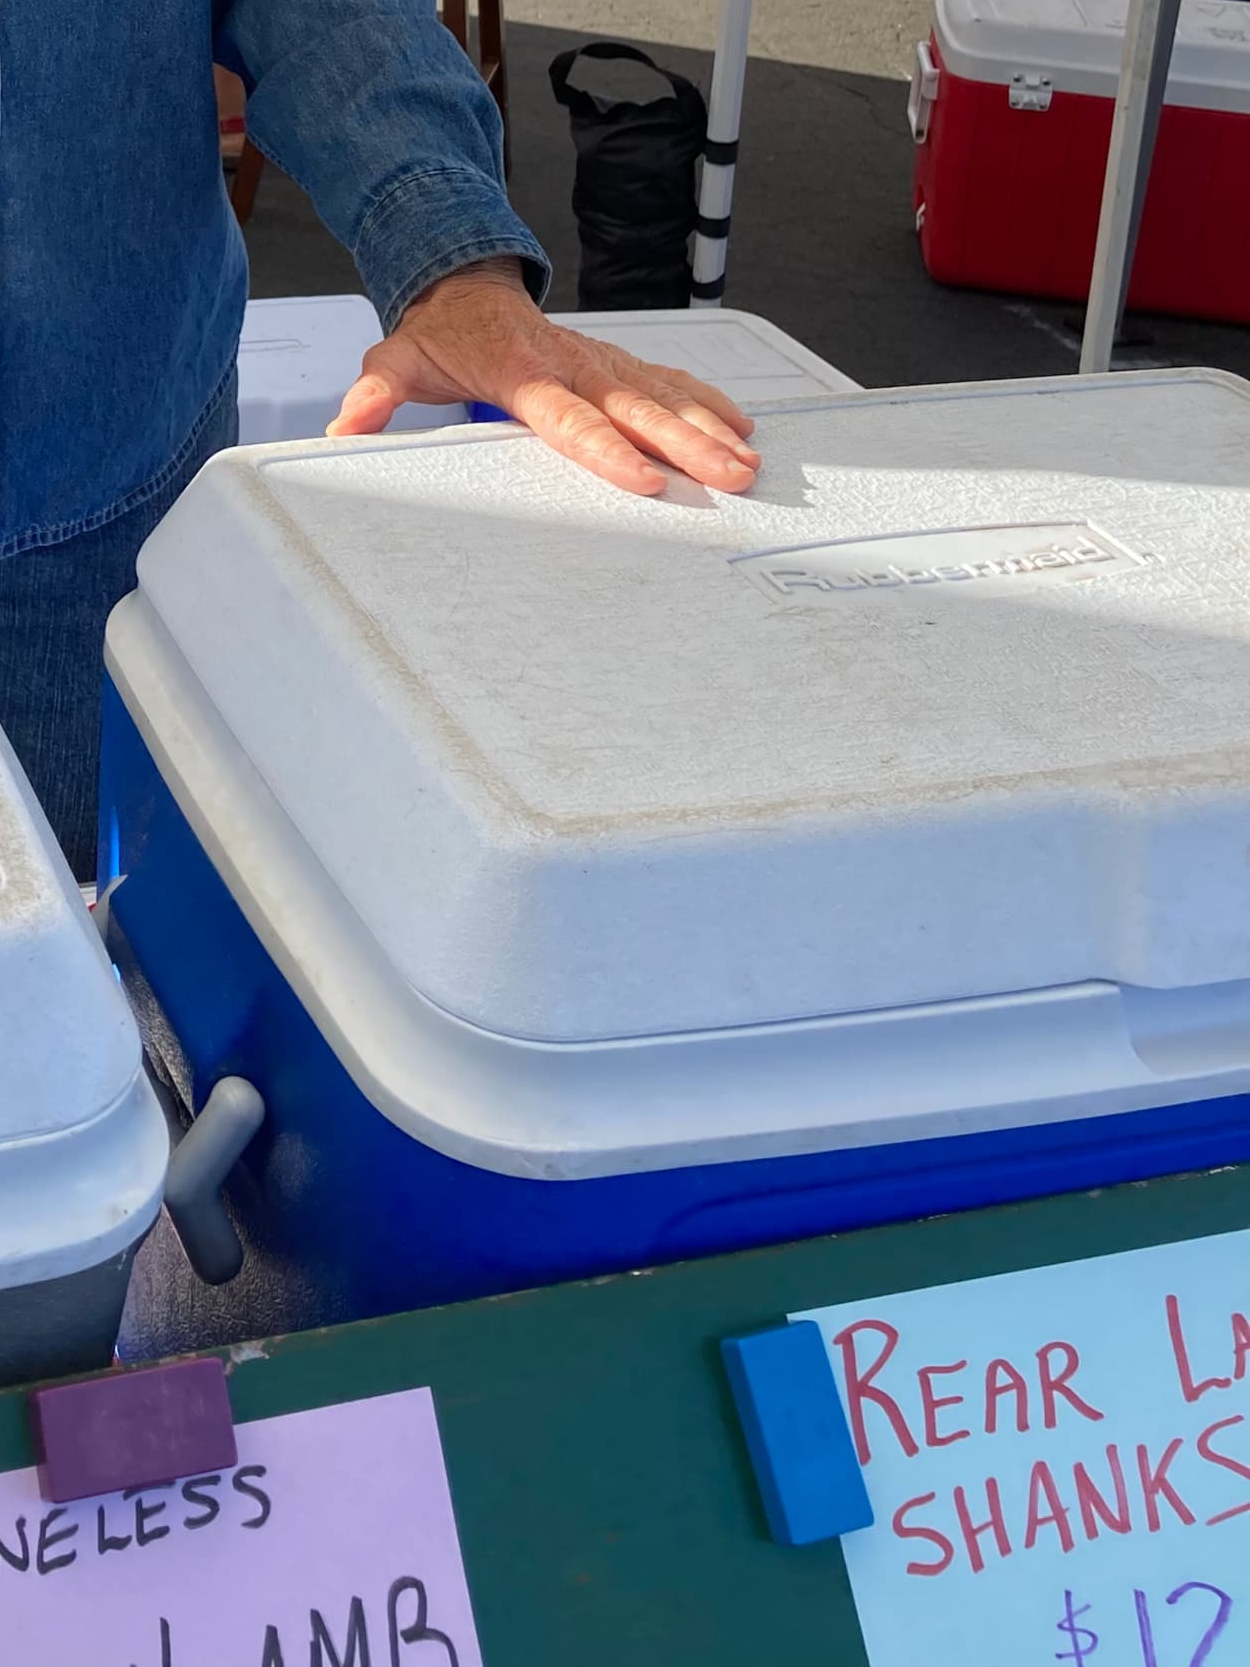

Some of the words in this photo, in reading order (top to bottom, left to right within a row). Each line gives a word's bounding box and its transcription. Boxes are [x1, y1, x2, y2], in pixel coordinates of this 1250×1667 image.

[759, 536, 1116, 594] Rubbermaid
[833, 1318, 1105, 1467] REAR
[892, 1414, 1250, 1576] SHANKS
